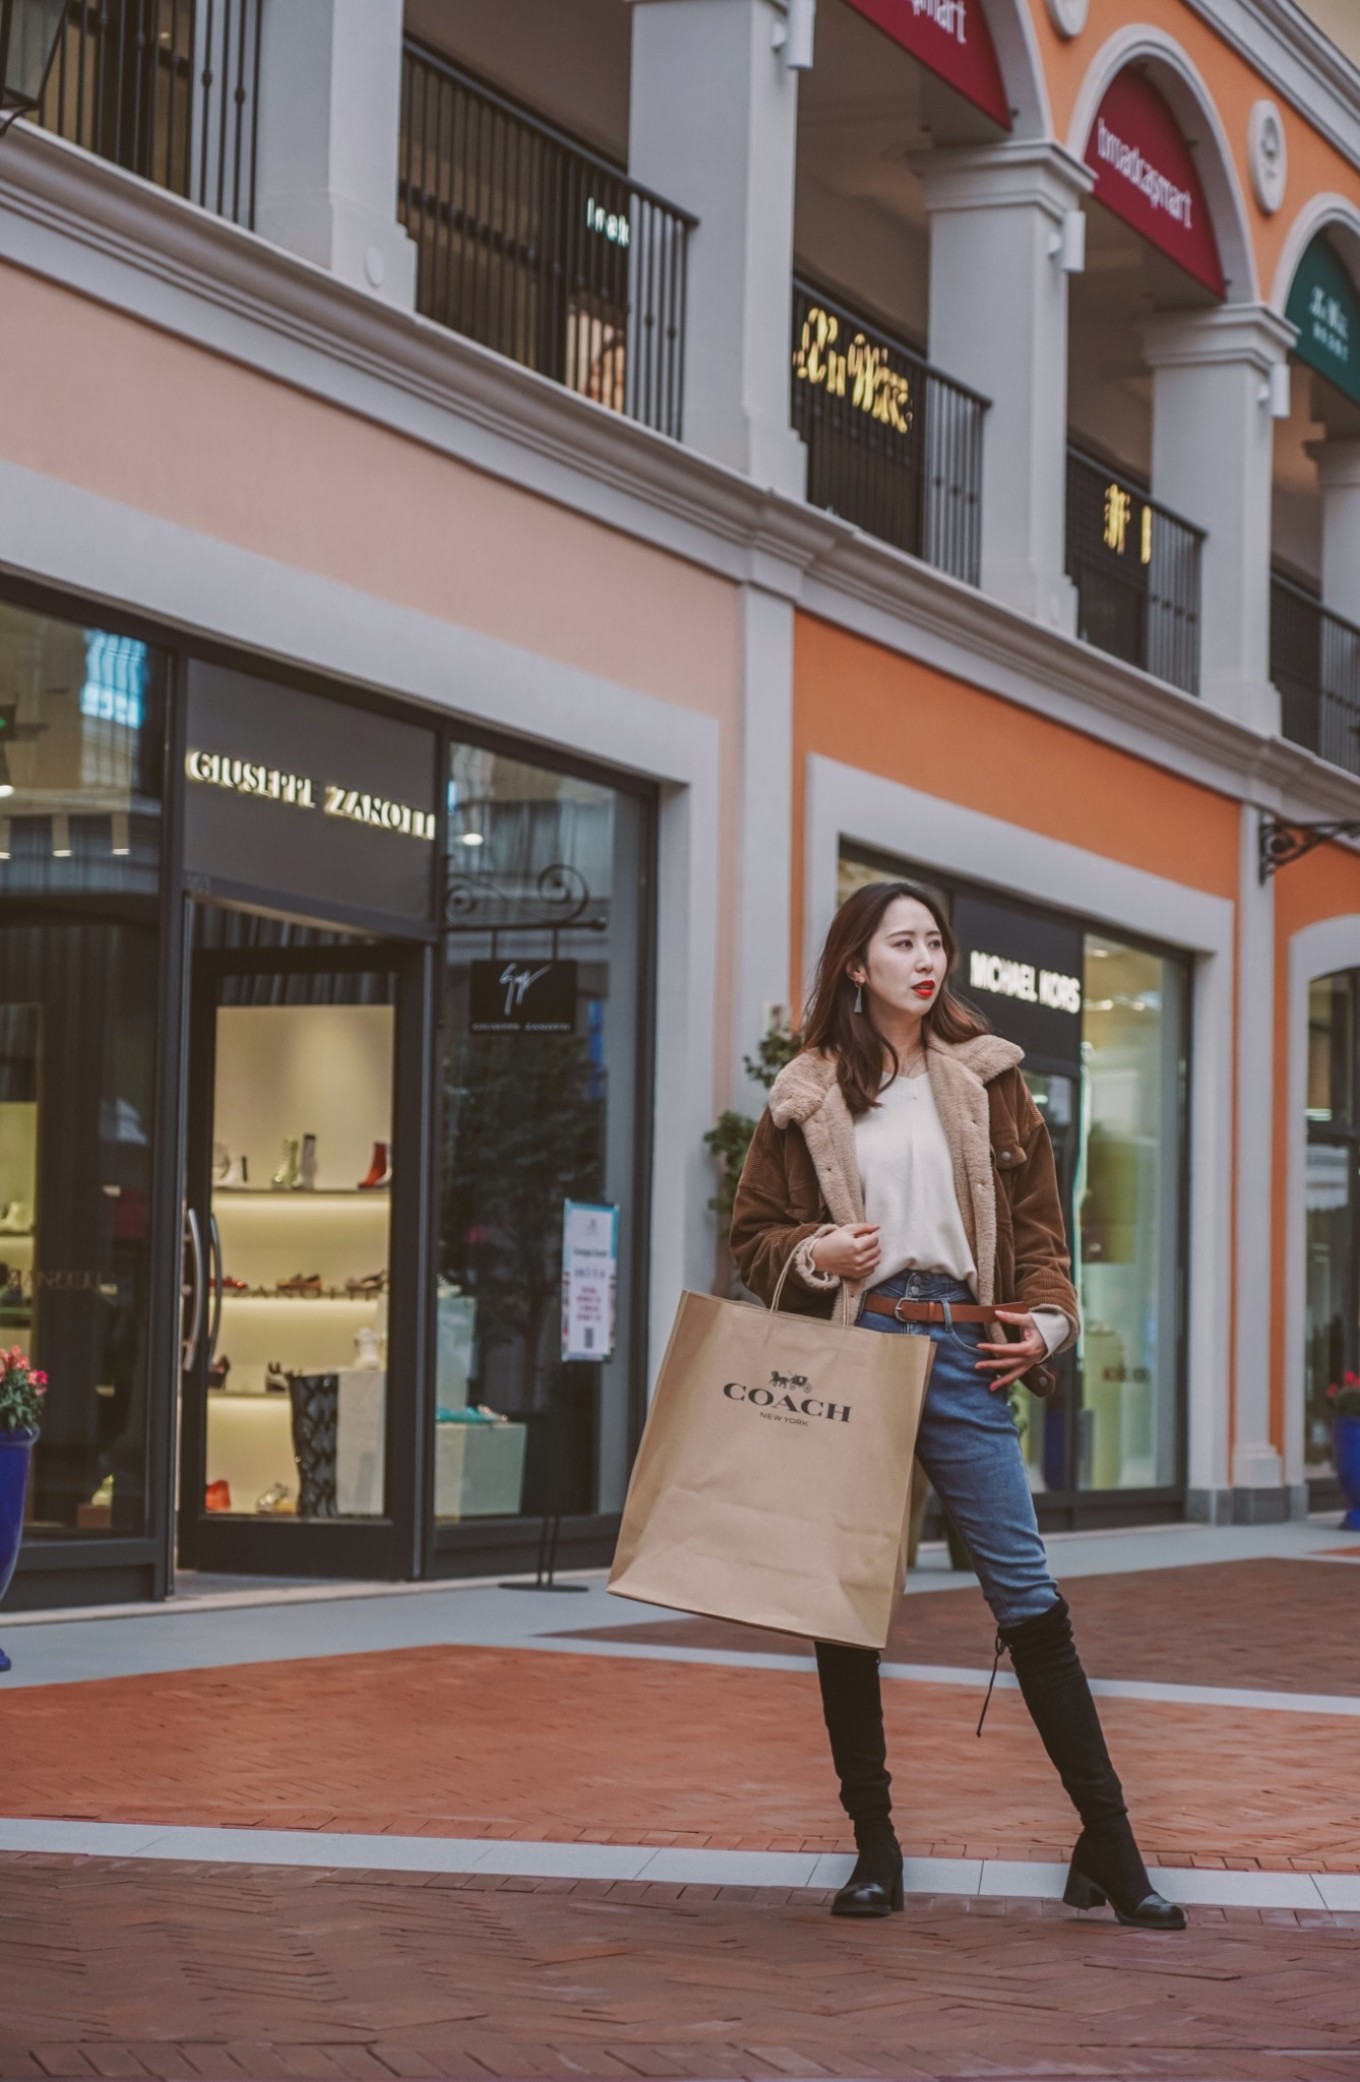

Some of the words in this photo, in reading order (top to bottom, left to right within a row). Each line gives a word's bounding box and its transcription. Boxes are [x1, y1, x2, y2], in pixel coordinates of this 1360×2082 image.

[184, 748, 320, 809] GIUSEPPE
[324, 784, 436, 840] ZANOTTI
[970, 950, 1038, 1002] MICHAEL
[1039, 969, 1081, 1014] KORS
[723, 1382, 852, 1423] COACH
[759, 1412, 782, 1422] NEW
[784, 1416, 809, 1427] YORK
